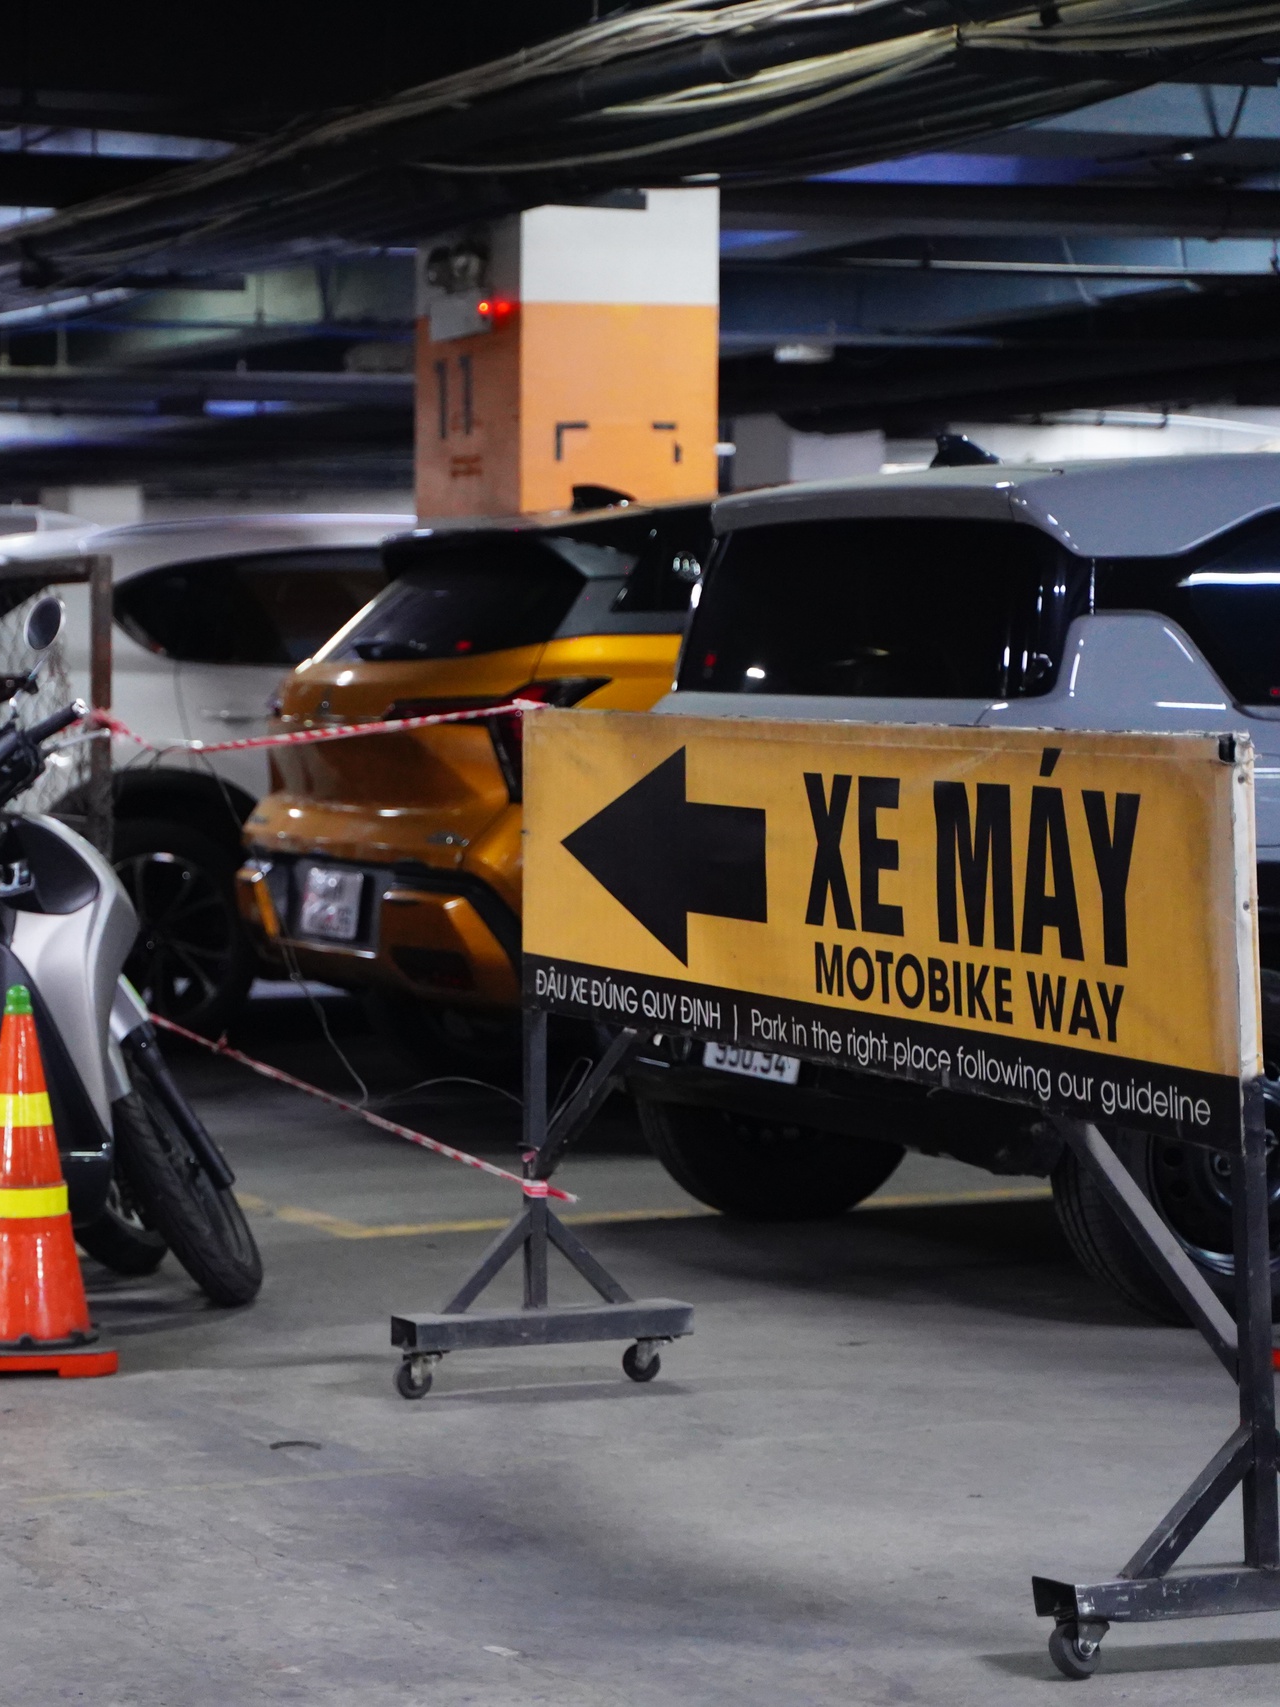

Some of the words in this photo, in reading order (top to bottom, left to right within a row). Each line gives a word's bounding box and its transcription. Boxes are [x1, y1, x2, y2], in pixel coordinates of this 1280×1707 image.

[803, 772, 905, 937] XE
[933, 747, 1142, 968] MÁY
[535, 966, 567, 1003] ĐẬU
[570, 976, 588, 1005] XE
[590, 976, 639, 1014] ĐÚNG
[641, 989, 677, 1022] QUY
[680, 995, 721, 1031] ĐỊNH
[751, 1009, 789, 1042] Park
[791, 1018, 808, 1047] in
[811, 1021, 842, 1054] the
[847, 1027, 889, 1066] right
[893, 1040, 952, 1073] place
[956, 1046, 1051, 1101] following
[1058, 1071, 1095, 1102] our
[1100, 1078, 1212, 1126] guideline
[814, 941, 1014, 1025] MOTOBIKE
[1026, 970, 1125, 1043] WAY
